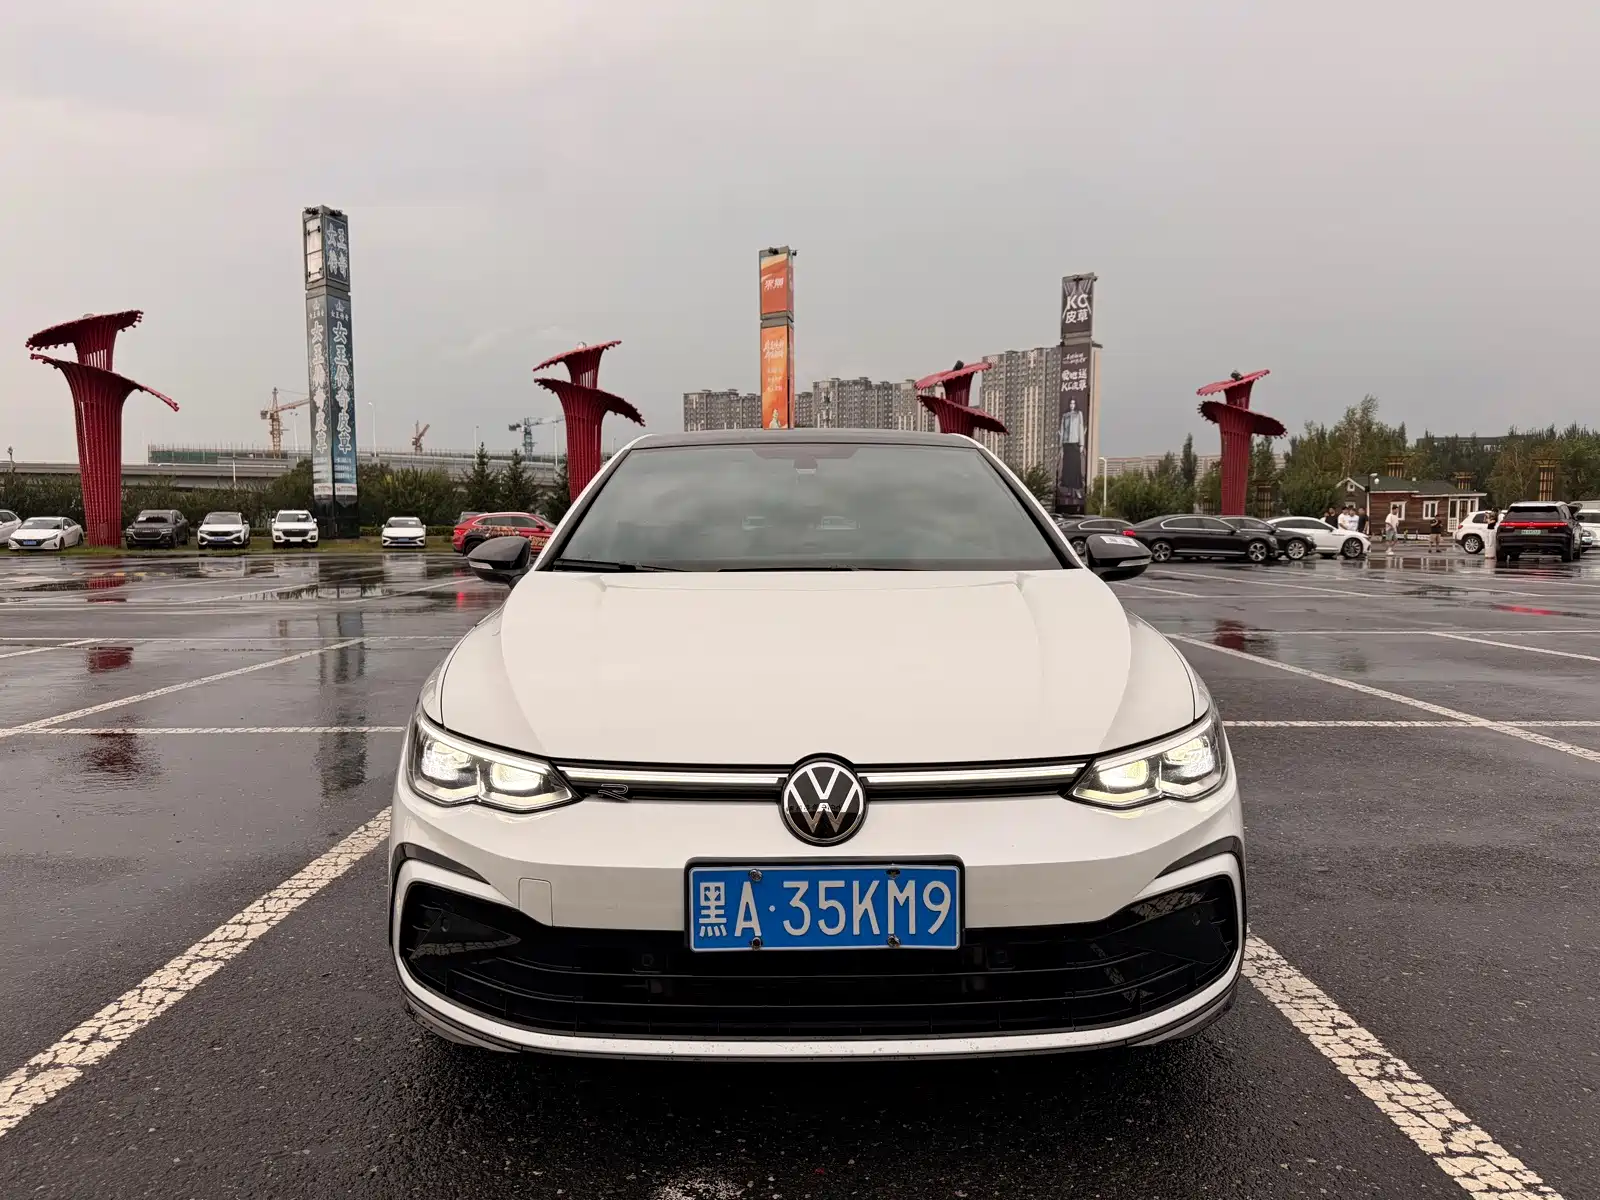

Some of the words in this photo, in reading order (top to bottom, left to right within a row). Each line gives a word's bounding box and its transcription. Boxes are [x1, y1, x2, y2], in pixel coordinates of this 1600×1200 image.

[326, 223, 347, 250] 女王
[1066, 294, 1089, 310] KC
[333, 320, 352, 454] 女王传奇皮草
